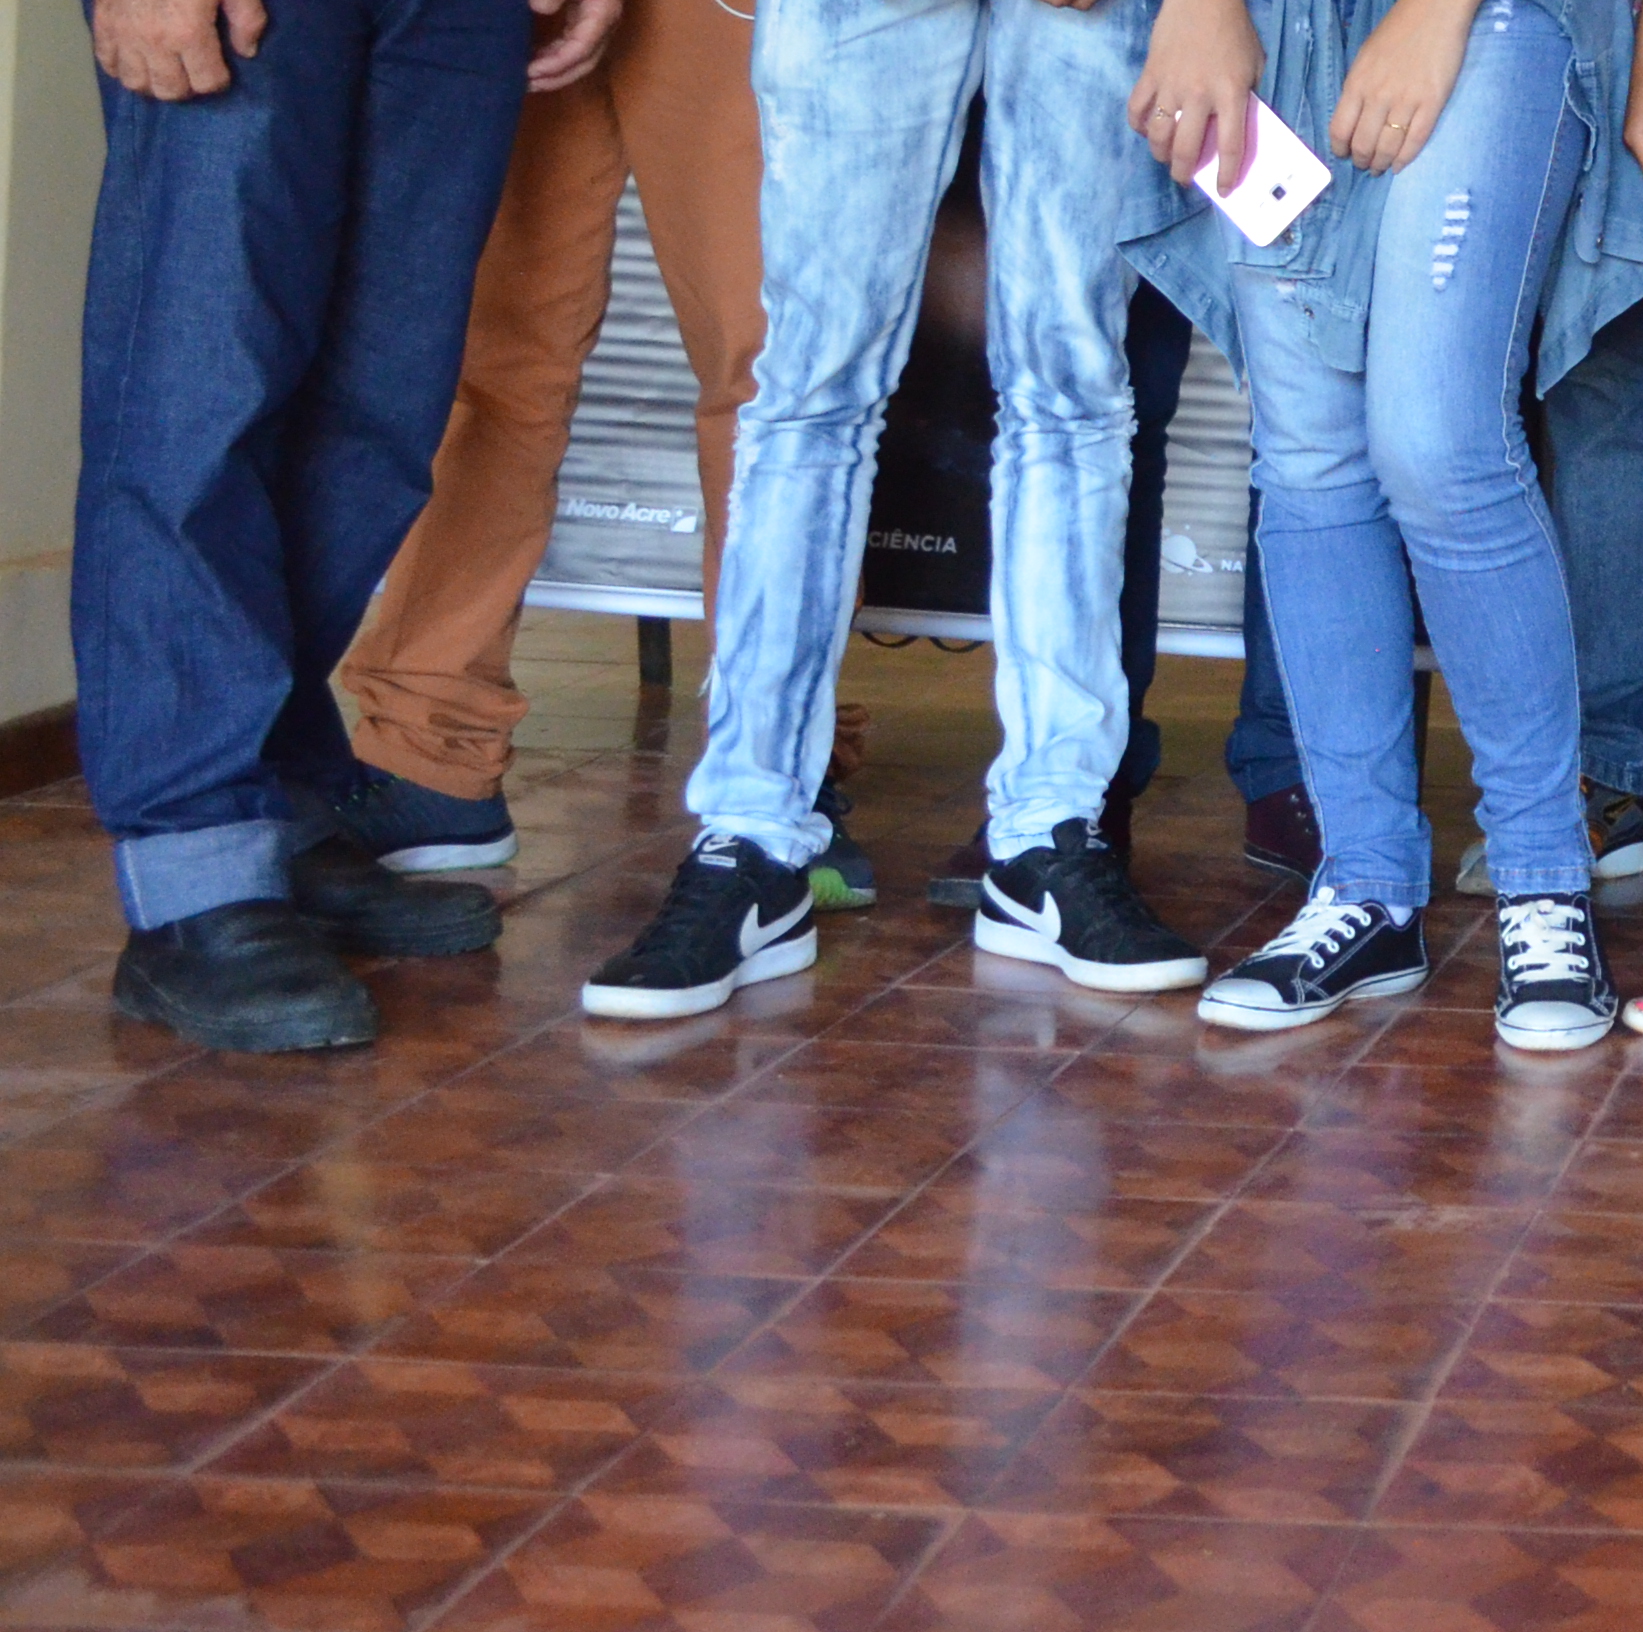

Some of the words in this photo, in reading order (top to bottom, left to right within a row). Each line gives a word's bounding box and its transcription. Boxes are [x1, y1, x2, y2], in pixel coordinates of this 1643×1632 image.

[565, 498, 619, 519] Novo
[620, 502, 672, 523] Acre
[868, 528, 957, 554] CIÊNCIA
[1221, 559, 1243, 573] NA
